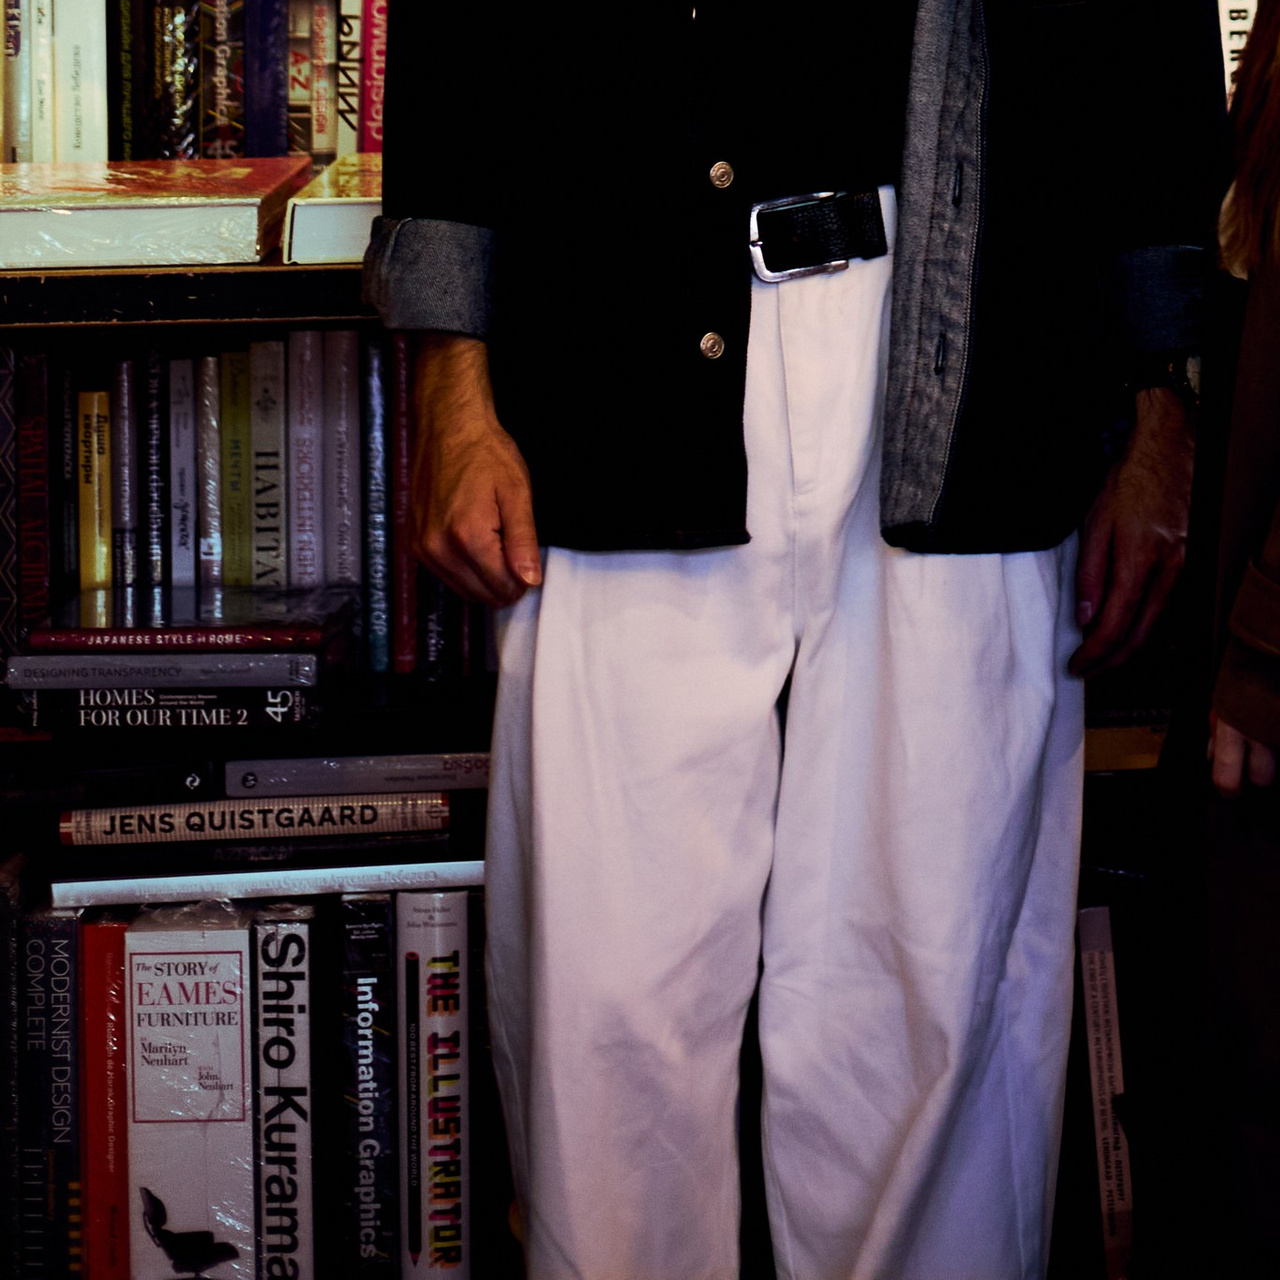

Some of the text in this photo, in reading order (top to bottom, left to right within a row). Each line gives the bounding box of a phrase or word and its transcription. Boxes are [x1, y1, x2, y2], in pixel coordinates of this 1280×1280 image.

[210, 44, 231, 126] Graphics
[289, 49, 311, 92] A-Z
[82, 413, 95, 484] квартиры
[94, 414, 108, 456] Душа
[230, 438, 242, 493] МЕЧТЫ
[254, 450, 281, 589] HABITA
[87, 635, 151, 646] JAPANESE
[156, 635, 194, 646] STYLE
[23, 666, 182, 679] DESIGNING TRANSPARENCY
[79, 689, 156, 707] HOMES
[265, 690, 294, 724] 45
[79, 709, 249, 726] FOR OUR TIME 2
[103, 804, 379, 837] JENS QUISTGAARD
[136, 961, 219, 977] The STORY of
[26, 939, 46, 1052] COMPLETE
[136, 980, 239, 1007] EAMES
[136, 1010, 239, 1028] FURNITURE
[51, 939, 71, 1144] MODERNIST DESIGN
[105, 1022, 116, 1058] Rudolph
[140, 1042, 188, 1057] Marilyn
[140, 1054, 189, 1067] Neuhart
[198, 1071, 220, 1082] John
[198, 1080, 235, 1092] Neuhart
[105, 1101, 116, 1134] Graphic
[260, 931, 310, 1280] Shiro Kurama
[353, 977, 382, 1260] Information Graphics
[409, 1023, 419, 1186] 100 BEST FROM AROUND THE WORLD
[429, 950, 463, 1267] THE ILLUSTRATOR
[106, 1135, 117, 1173] Designer
[1102, 1137, 1113, 1181] LENINGRAD
